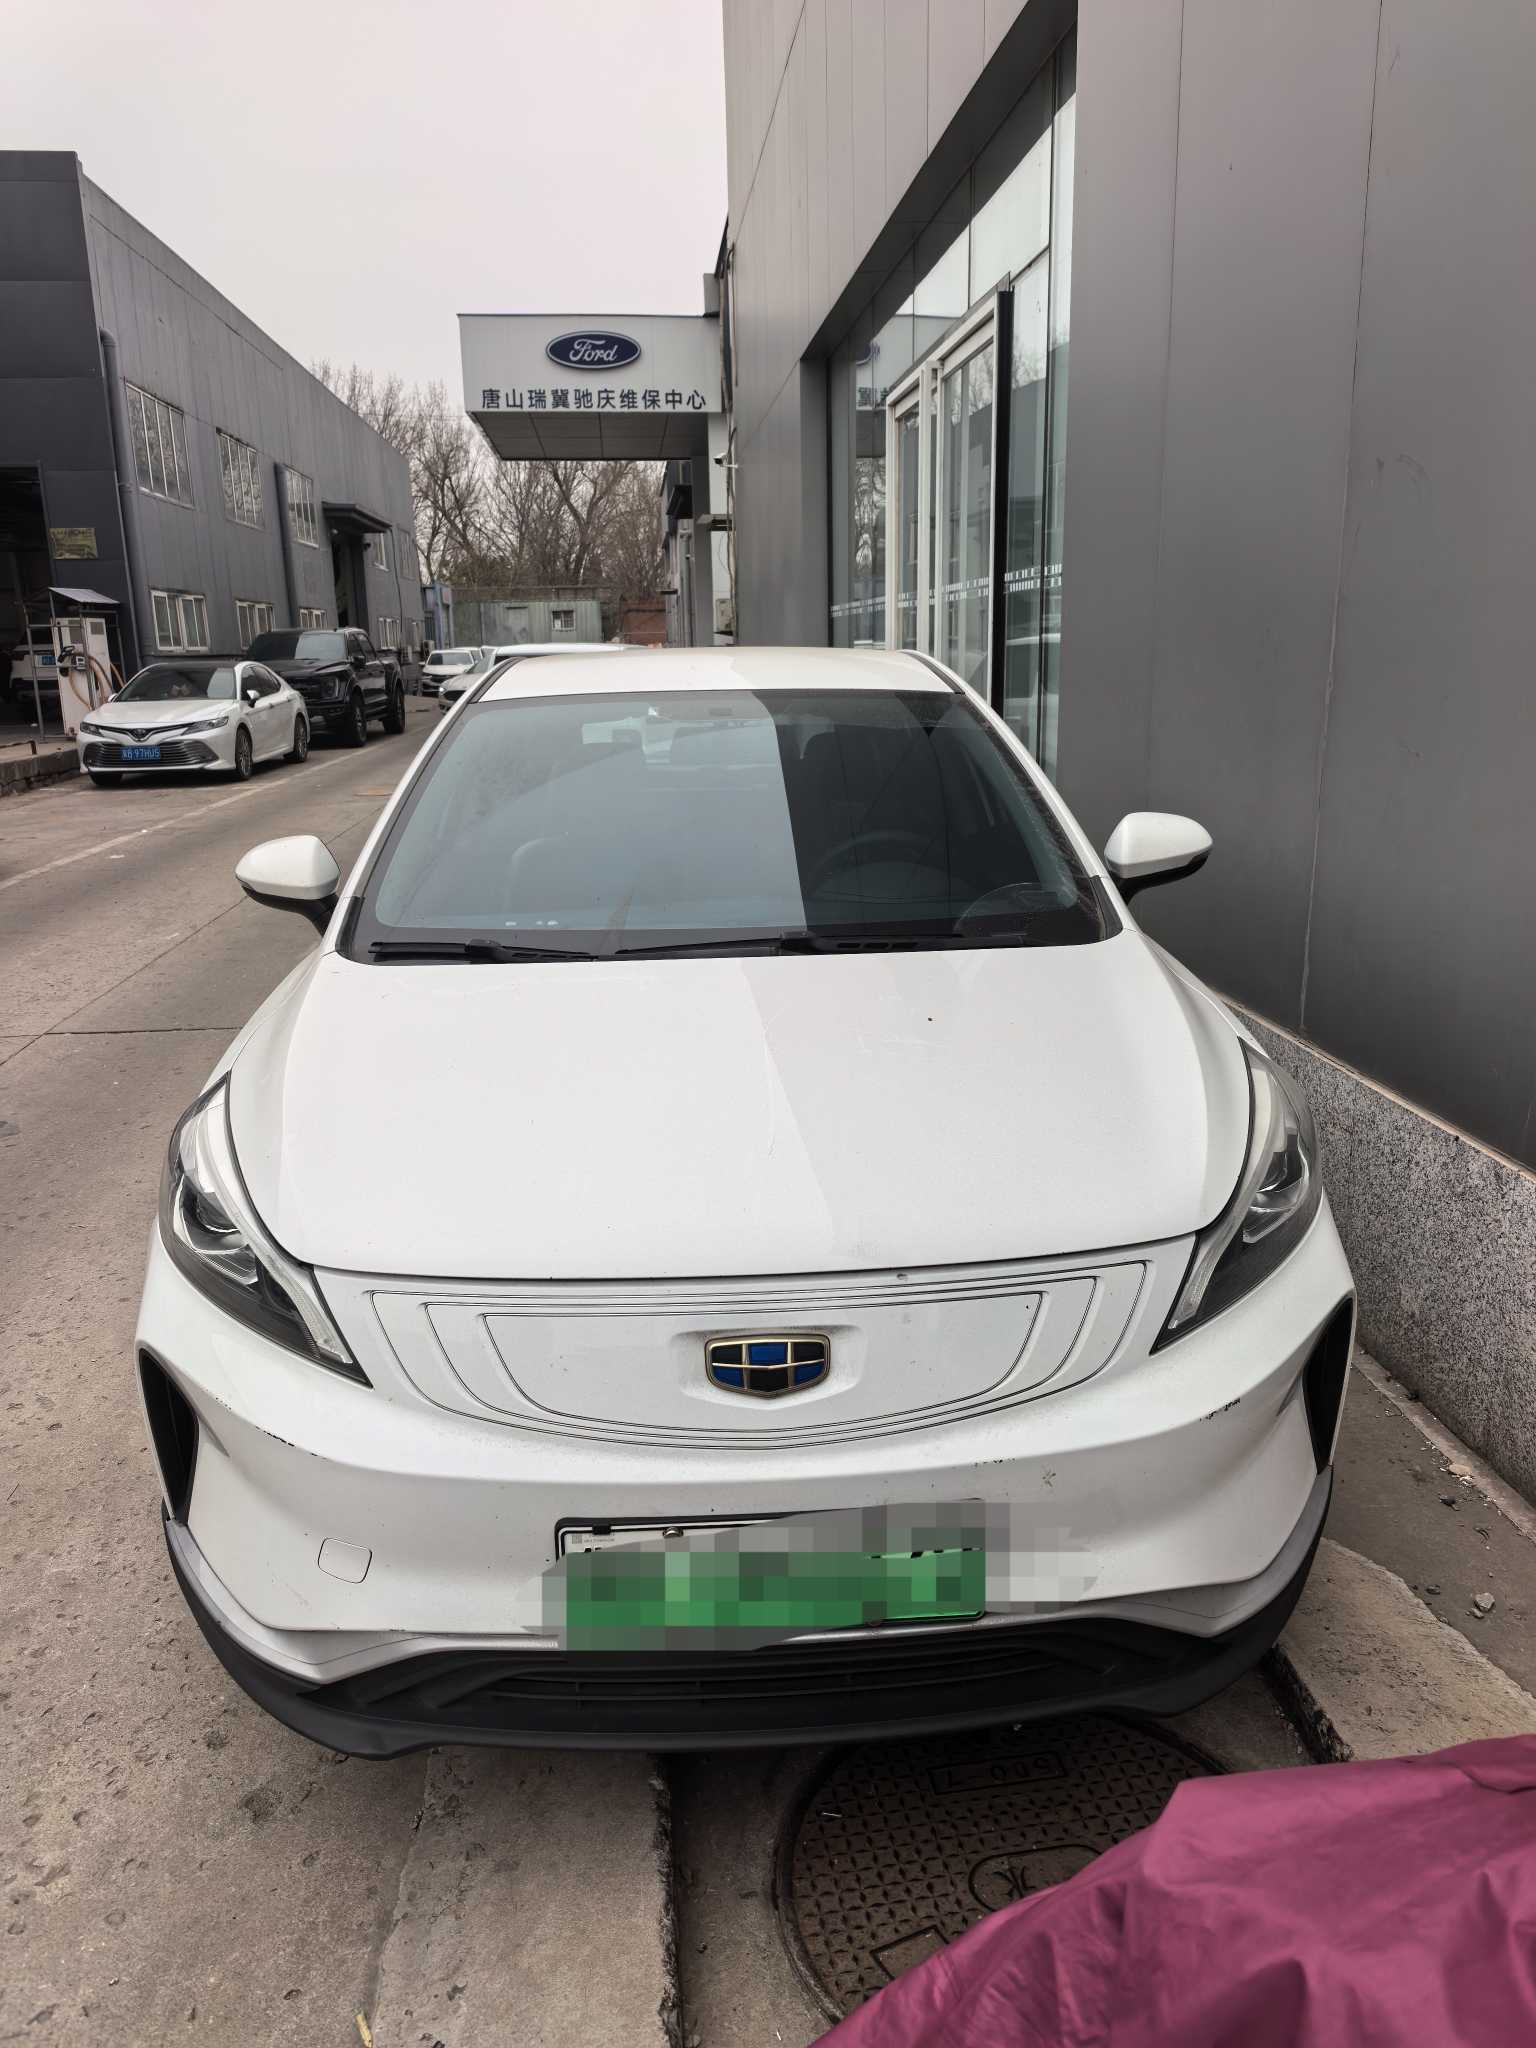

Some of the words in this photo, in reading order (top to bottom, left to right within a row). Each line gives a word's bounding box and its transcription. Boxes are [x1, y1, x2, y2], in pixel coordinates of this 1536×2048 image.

[569, 338, 618, 362] Ford
[481, 388, 707, 410] 唐山瑞冀驰庆维保中心
